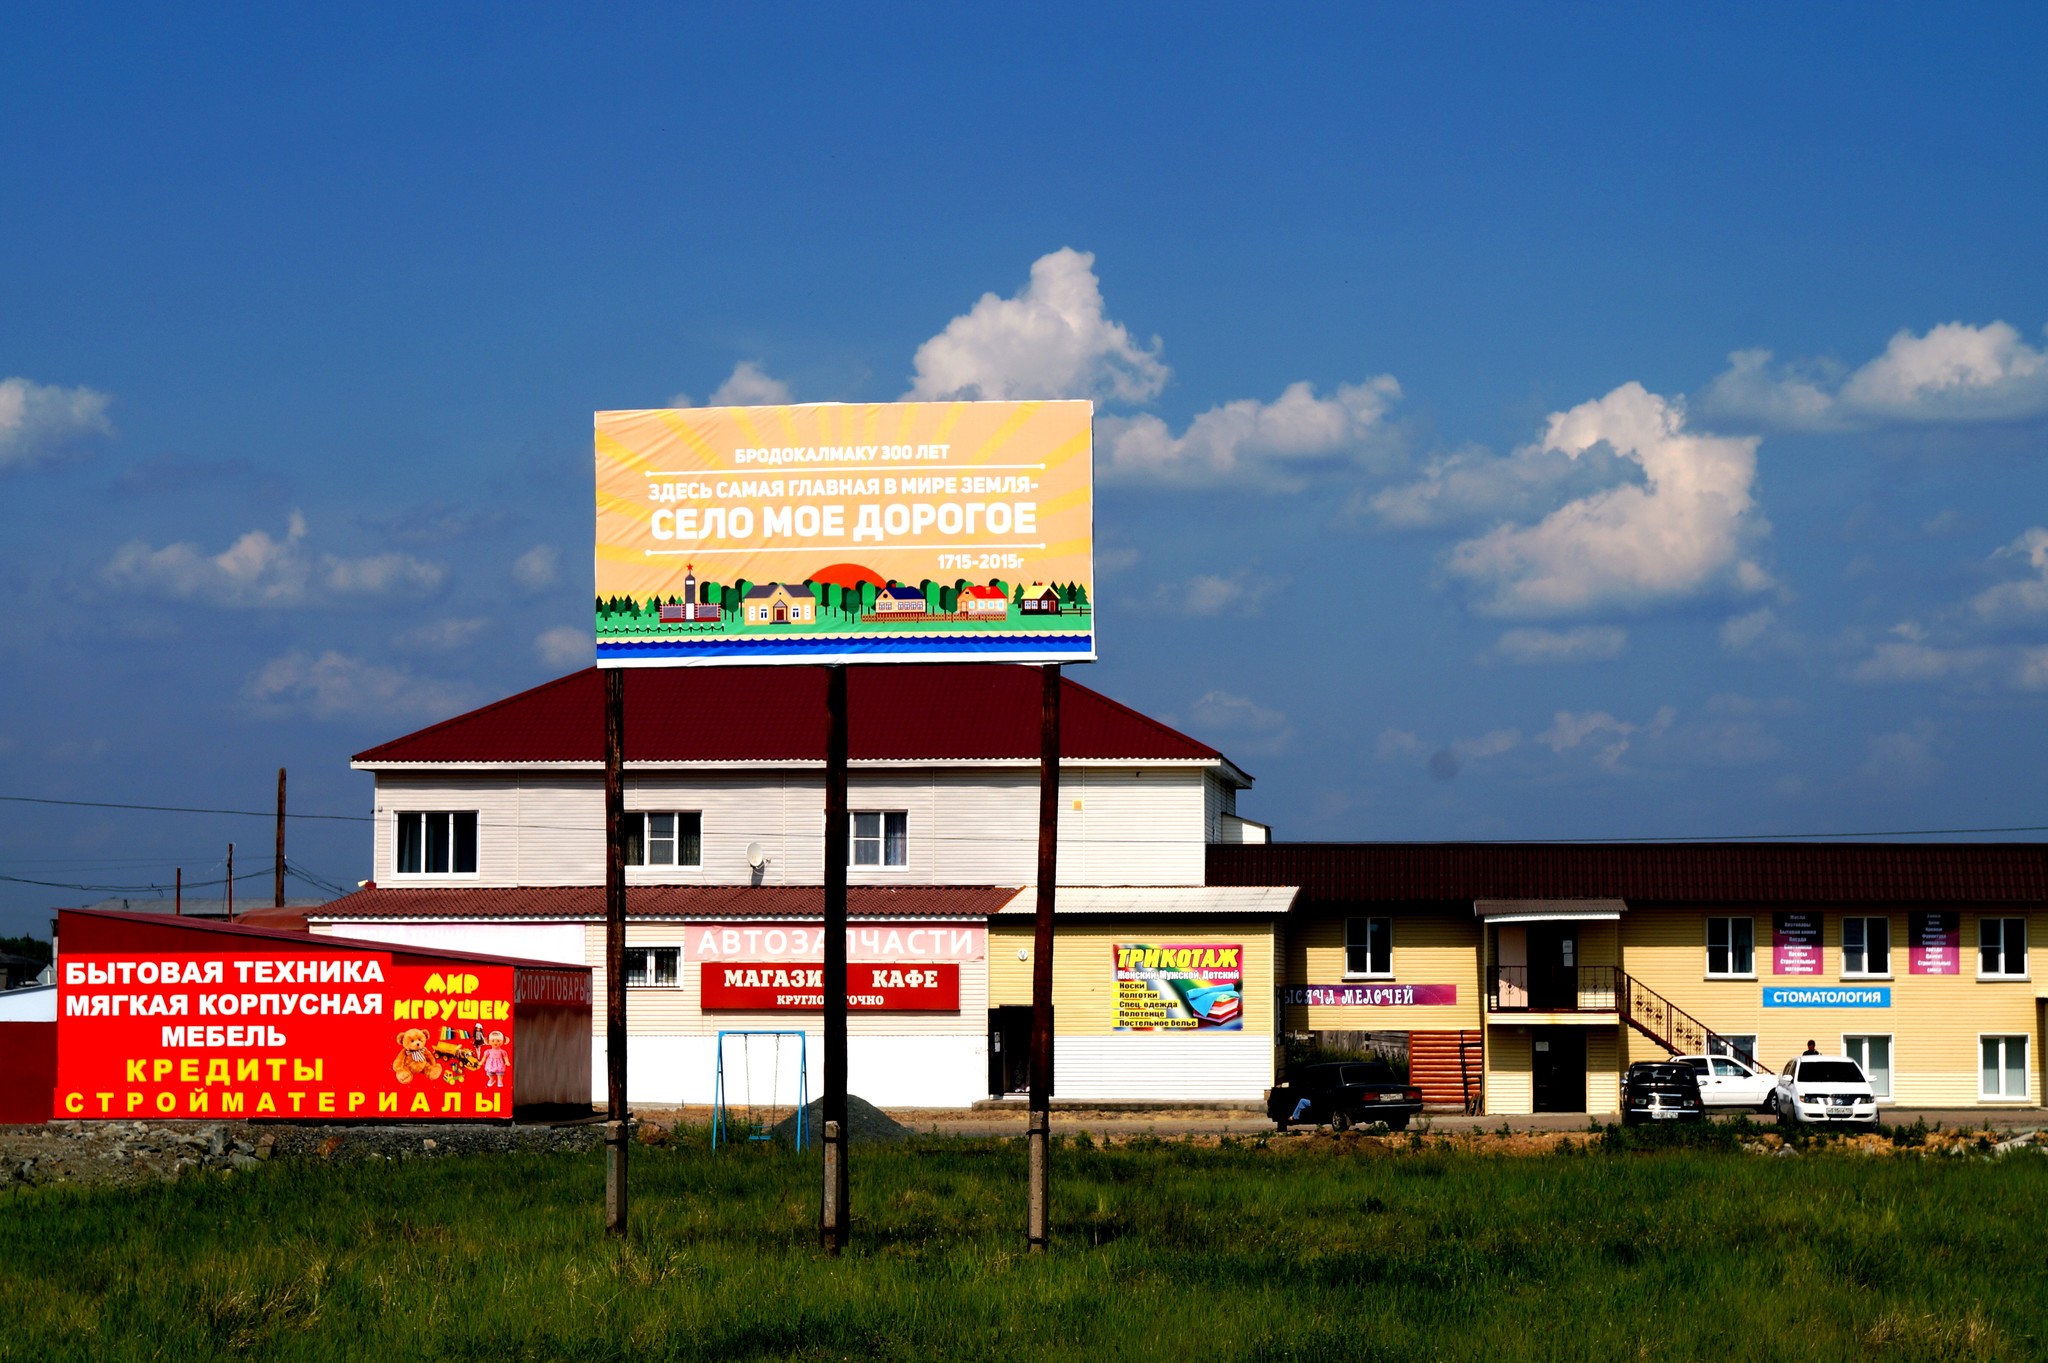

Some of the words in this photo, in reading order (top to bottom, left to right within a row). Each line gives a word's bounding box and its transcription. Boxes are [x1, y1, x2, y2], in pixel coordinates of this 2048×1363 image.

[734, 446, 878, 465] БРОДОКАЛМАКУ
[881, 445, 912, 460] 300
[915, 444, 950, 460] ЛЕТ
[648, 483, 713, 503] ЗДЕСЬ
[716, 480, 785, 499] САМАЯ
[788, 478, 880, 497] ГЛАВНАЯ
[884, 477, 898, 495] В
[901, 477, 957, 494] МИРЕ
[960, 476, 1039, 495] ЗЕМЛЯ-
[651, 506, 754, 541] СЕЛО
[763, 505, 845, 538] МОЕ
[852, 502, 1037, 542] ДОРОГОЕ
[937, 553, 1024, 570] 1715-2015г
[1117, 948, 1239, 968] ТРИКОТАЖ
[66, 961, 223, 985] БЫТОВАЯ
[233, 960, 385, 983] ТЕХНИКА
[724, 969, 824, 988] МАГАЗИ
[872, 969, 938, 988] КАФЕ
[1202, 970, 1239, 980] Детский
[424, 973, 479, 995] МИР
[520, 974, 586, 1001] СПОРТТОВАРЫ
[1284, 988, 1336, 1005] ЫСЯЧА
[1341, 985, 1414, 1005] МЕЛОЧЕЙ
[66, 994, 188, 1017] МЯГКАЯ
[199, 993, 383, 1017] КОРПУСНАЯ
[1773, 991, 1881, 1003] СТОМАТОЛОГИЯ
[393, 999, 510, 1021] ИГРУШЕК
[1119, 1010, 1165, 1018] Полотенце
[162, 1025, 287, 1047] МЕБЕЛЬ
[126, 1058, 324, 1086] КРЕДИТЫ
[65, 1088, 502, 1113] СТРОЙМАТЕРИАЛЫ
